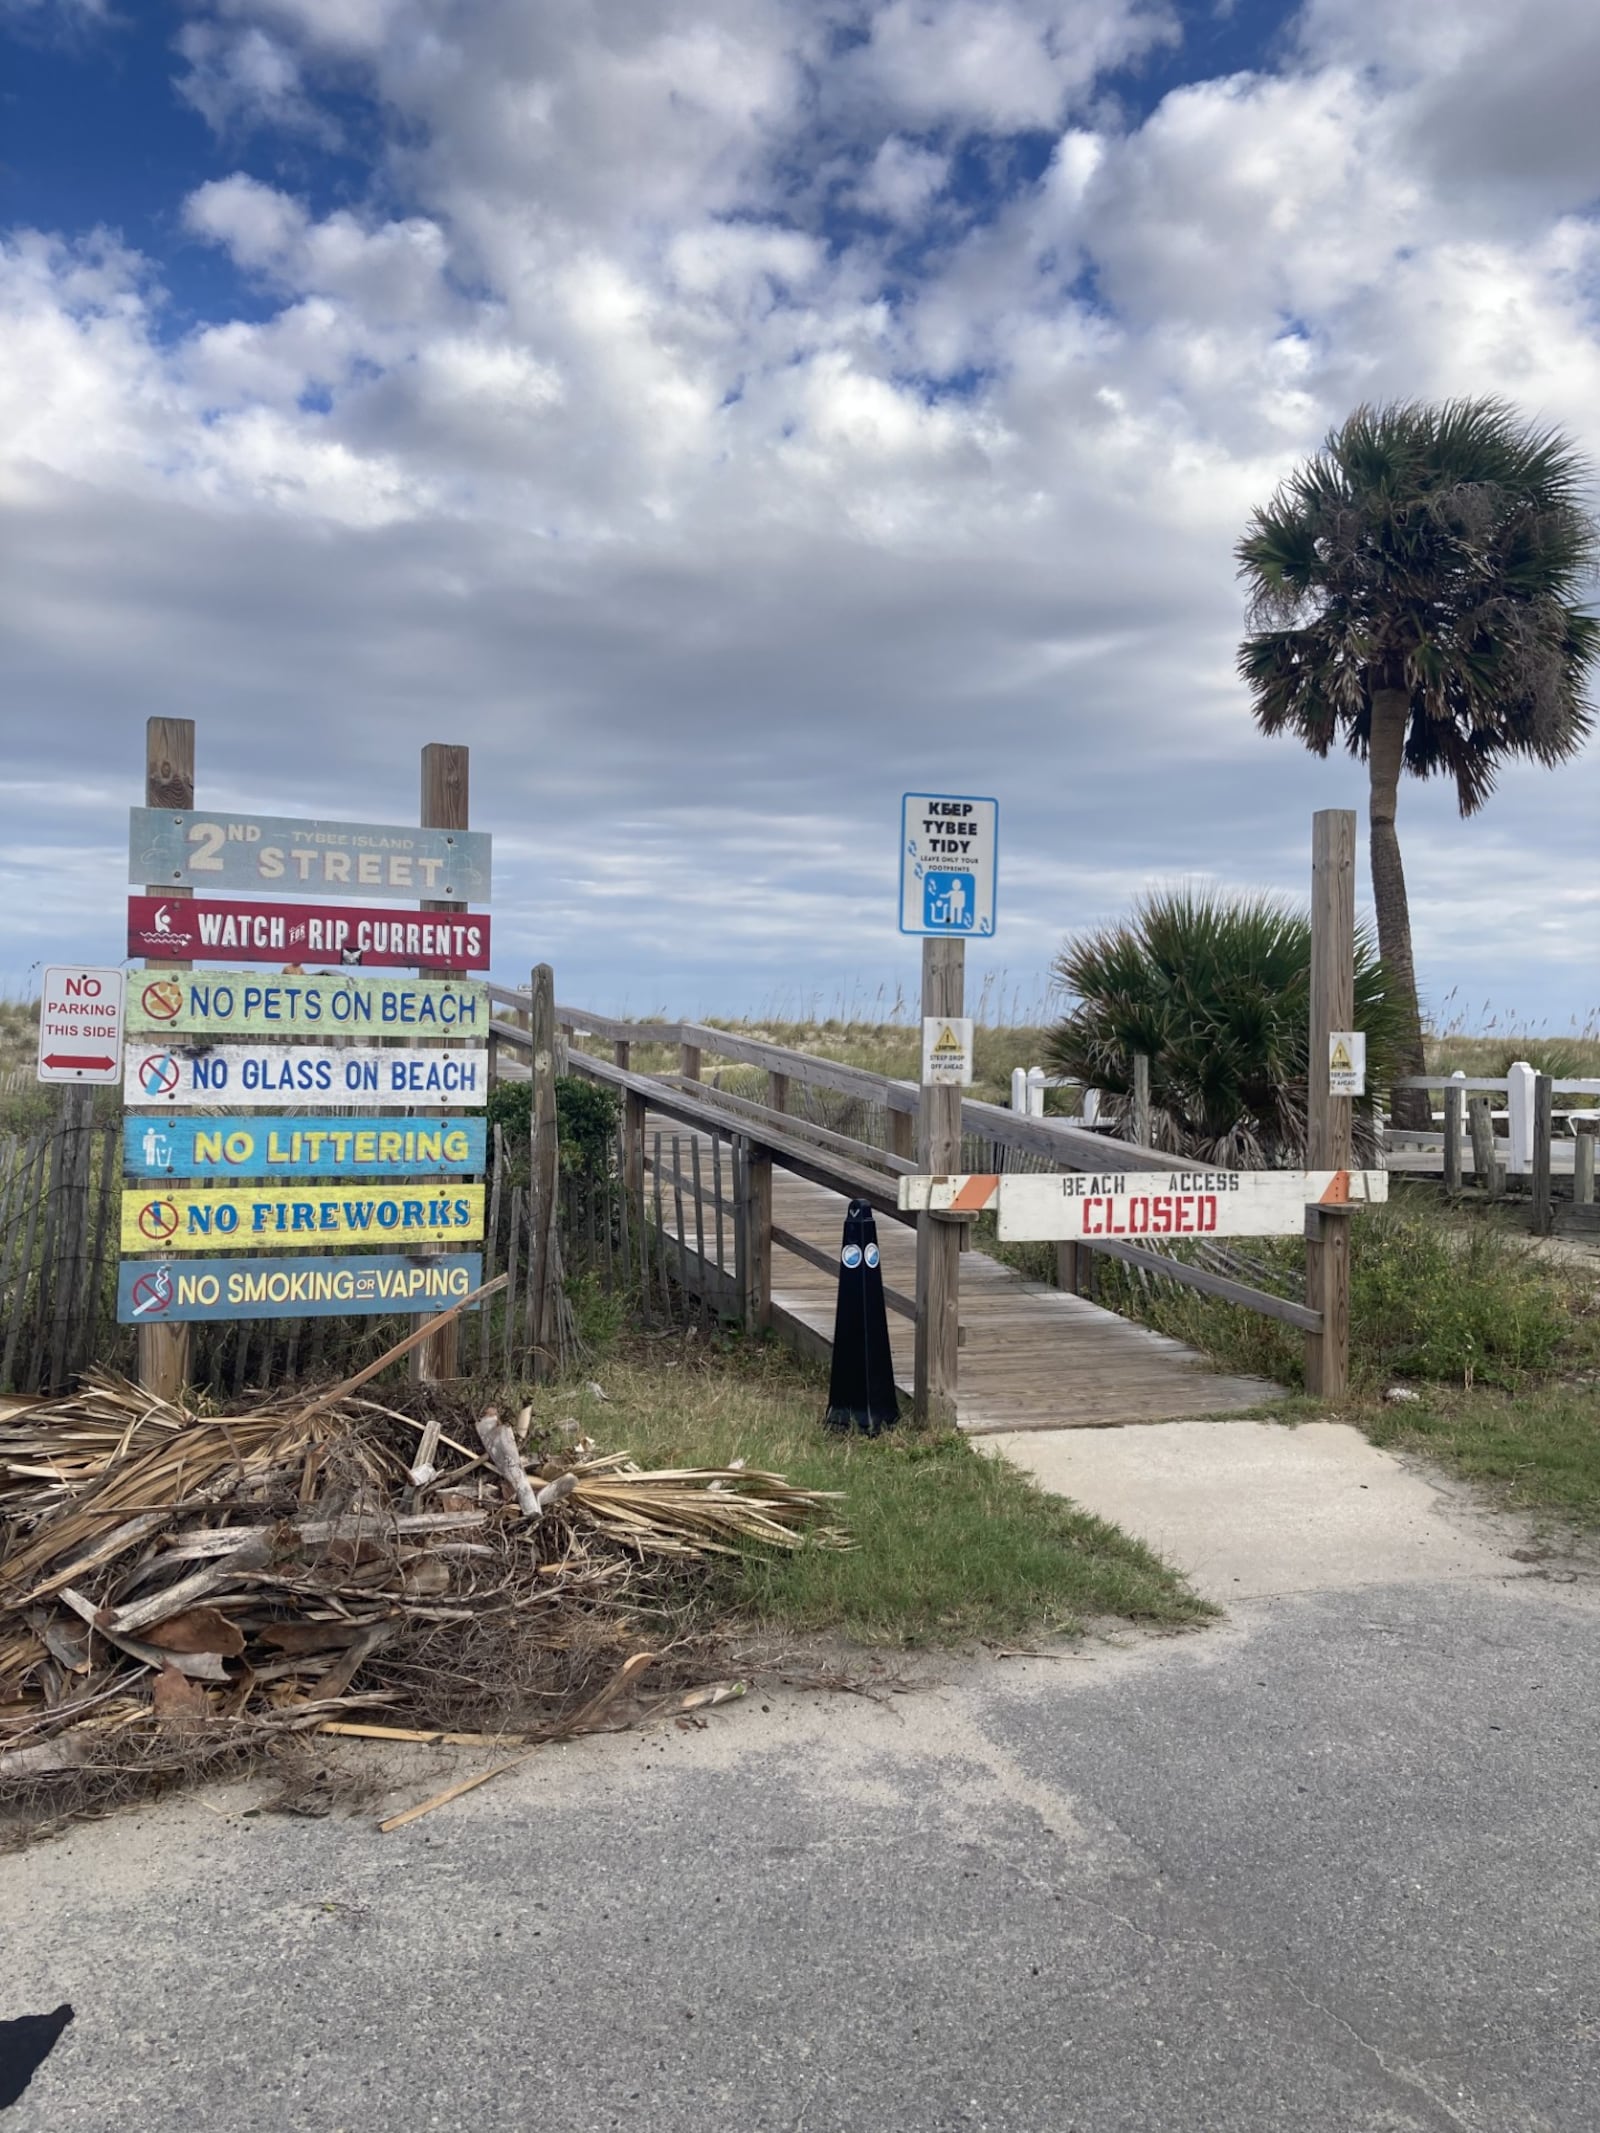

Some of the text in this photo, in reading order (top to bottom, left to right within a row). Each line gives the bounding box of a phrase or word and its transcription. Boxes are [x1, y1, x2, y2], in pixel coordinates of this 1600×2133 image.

[928, 802, 973, 817] KEEP
[922, 820, 978, 836] TYBEE
[291, 831, 414, 849] TYBEE ISLAND
[929, 839, 970, 854] TIDY
[259, 847, 443, 888] STREET
[928, 864, 970, 872] FOOTPRINTS
[198, 913, 285, 948] WATCH
[308, 918, 349, 950] RIP
[357, 920, 481, 957] CURRENTS
[65, 978, 102, 997] NO
[48, 1002, 116, 1016] PARKING
[190, 985, 476, 1023] NO PETS ON BEACH
[46, 1024, 116, 1038] THIS SIDE
[192, 1058, 476, 1091] NO GLASS ON BEACH
[193, 1131, 469, 1164] NO LITTERING
[1063, 1173, 1239, 1196] BEACH ACCESS
[187, 1199, 470, 1234] NO FIREWORKS
[1082, 1195, 1217, 1234] CLOSED
[177, 1268, 469, 1305] NO SMOKING OR VAPING
